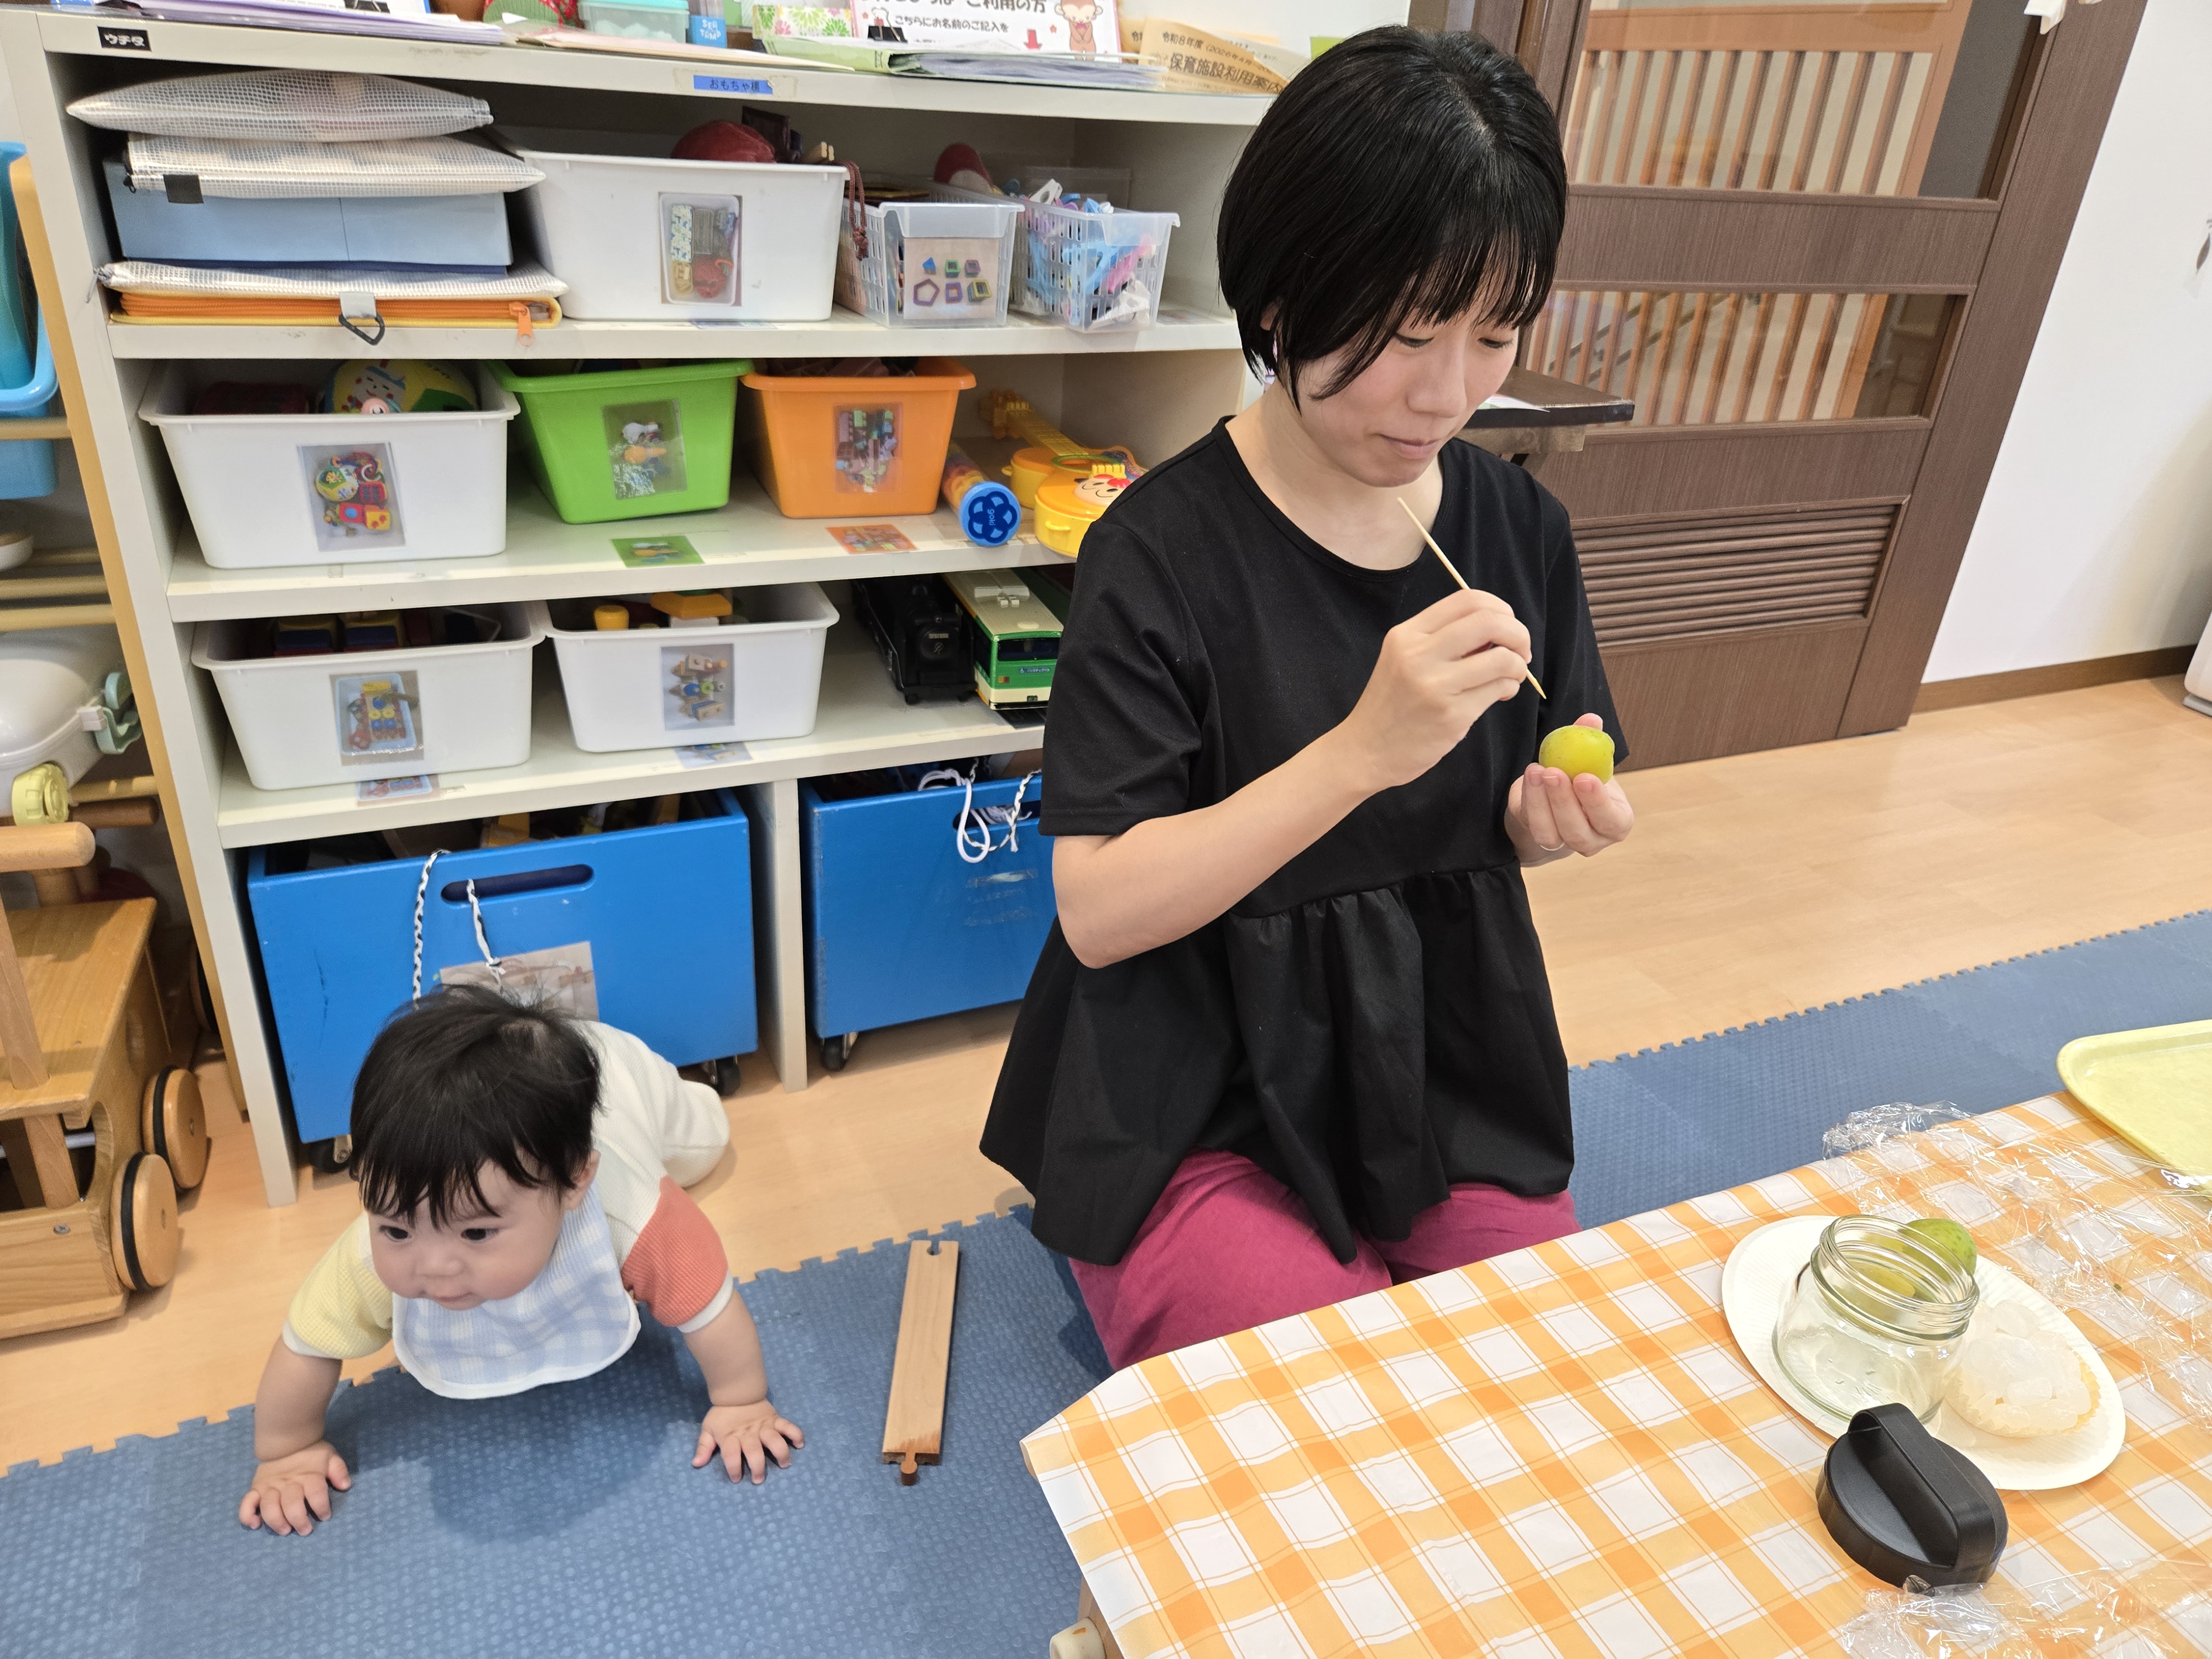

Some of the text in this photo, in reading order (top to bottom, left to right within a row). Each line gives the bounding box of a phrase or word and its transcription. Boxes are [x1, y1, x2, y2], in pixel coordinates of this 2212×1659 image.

[895, 15, 1009, 33] こちらにお名前のご記入を
[1169, 53, 1284, 94] 保育施設利用案内
[987, 509, 995, 526] goki
